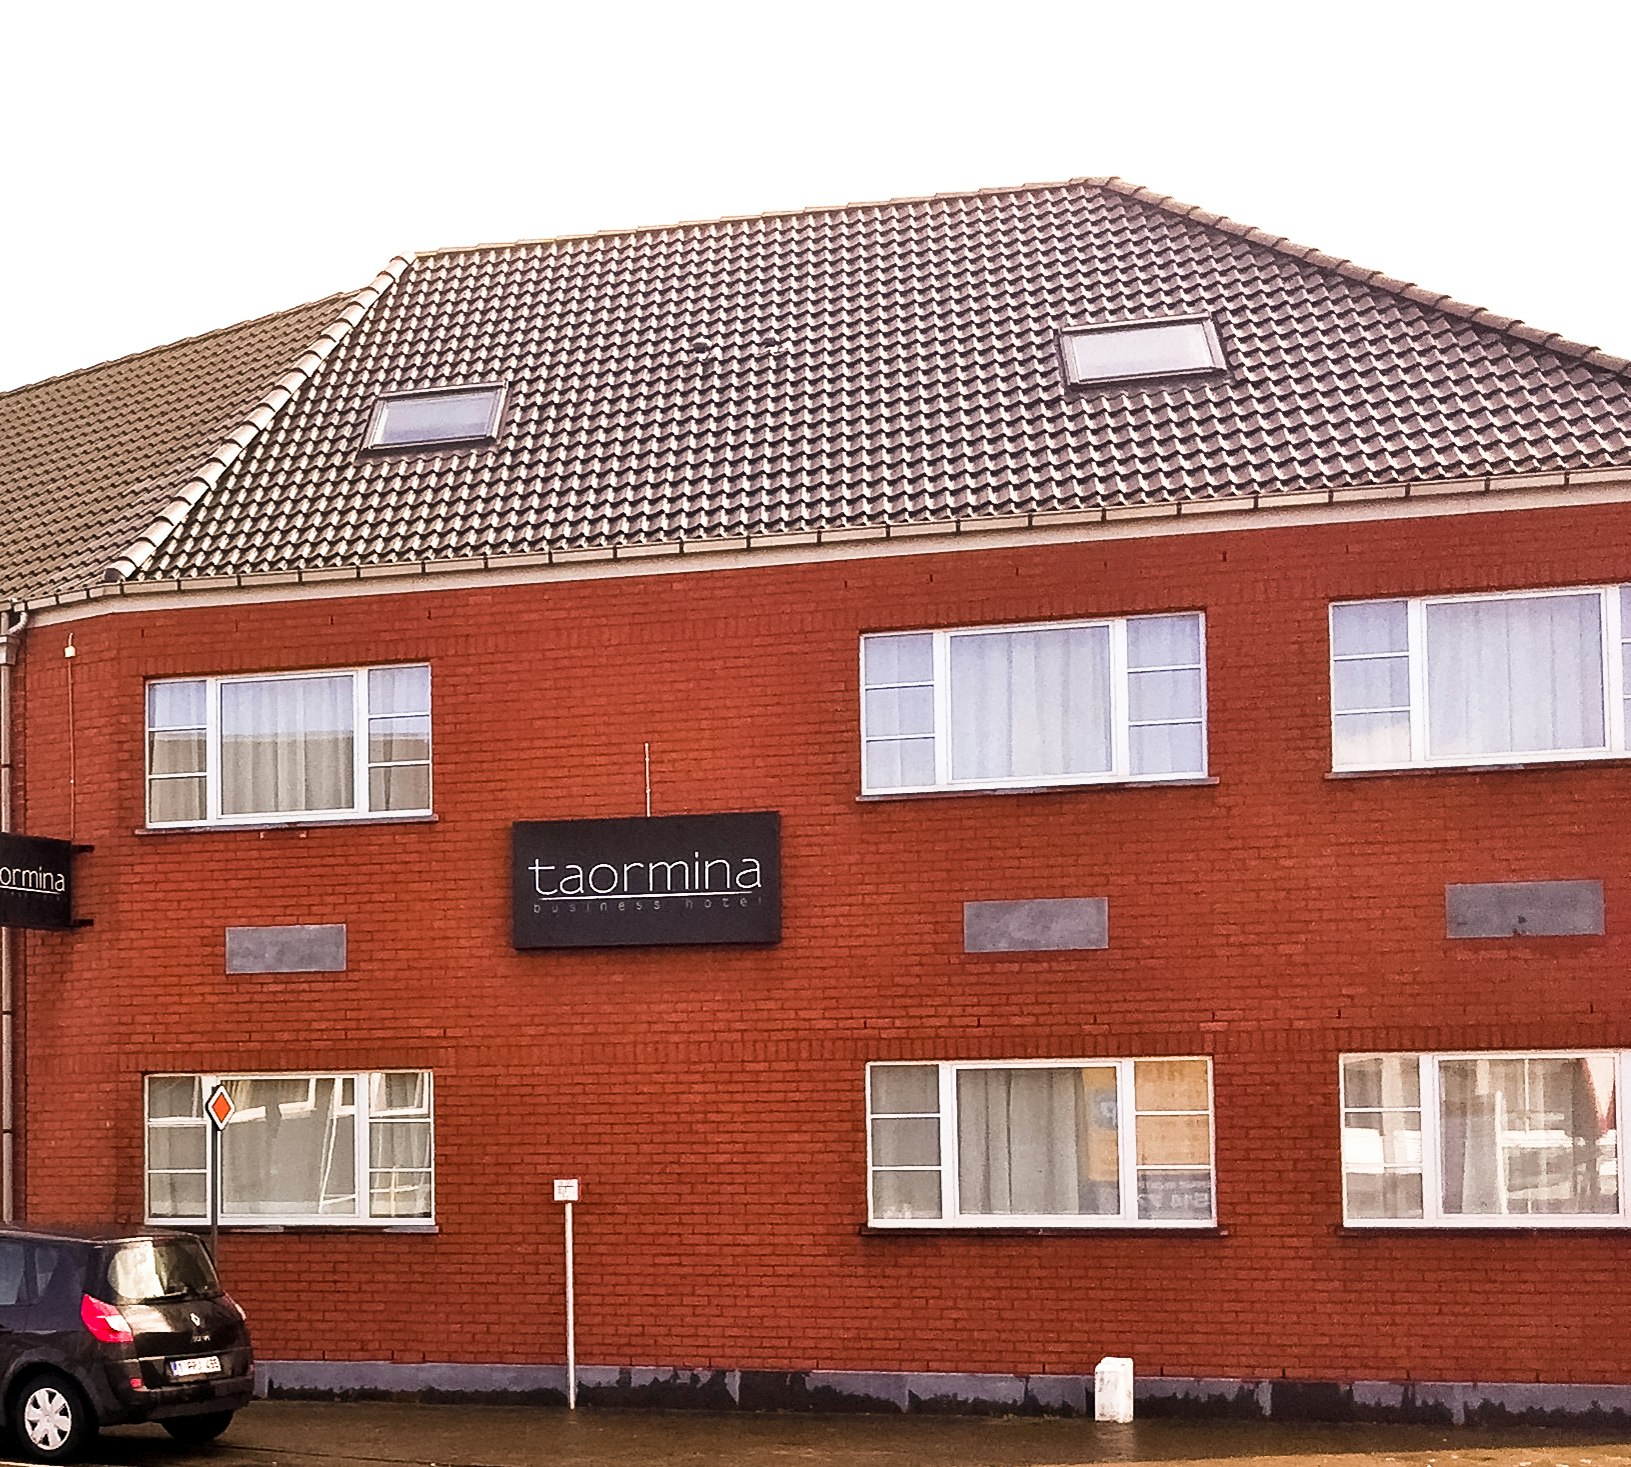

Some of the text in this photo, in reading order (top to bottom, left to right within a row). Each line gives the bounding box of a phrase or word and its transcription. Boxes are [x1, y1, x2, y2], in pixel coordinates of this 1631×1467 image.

[528, 851, 762, 896] taormina
[533, 897, 763, 914] business hotel
